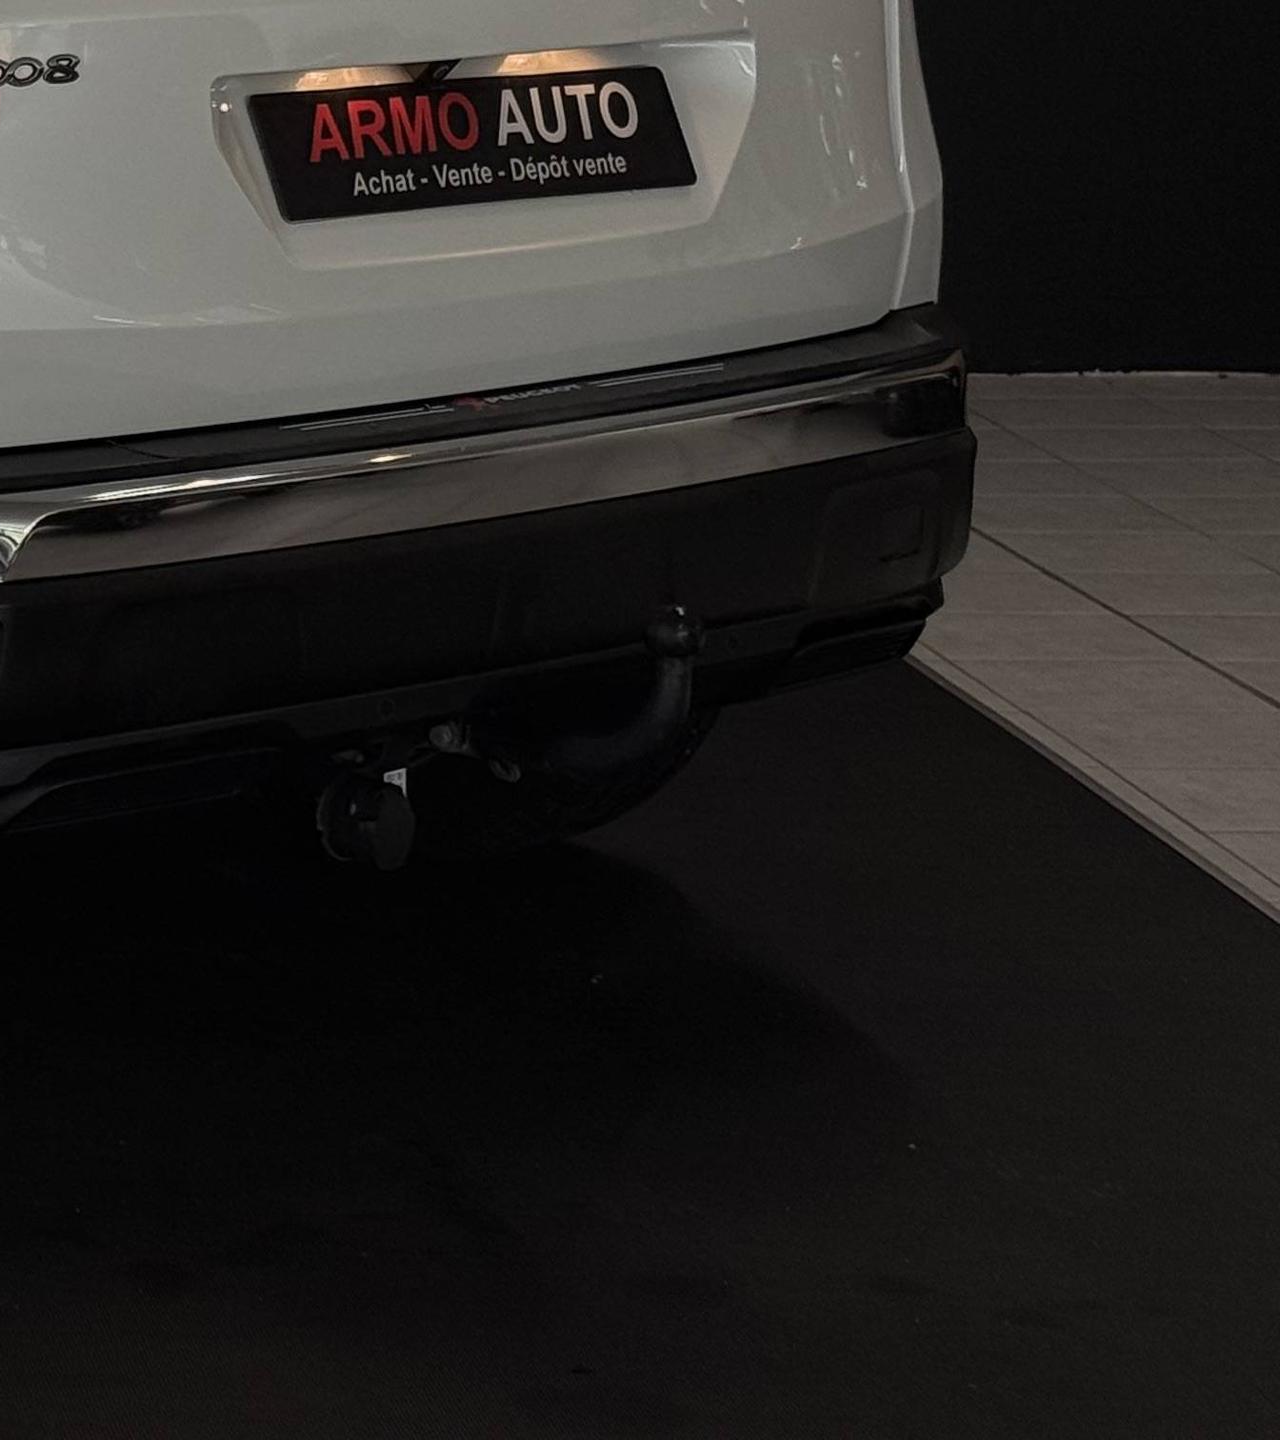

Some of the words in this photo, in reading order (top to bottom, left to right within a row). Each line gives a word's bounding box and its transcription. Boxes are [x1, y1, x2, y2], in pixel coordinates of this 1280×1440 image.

[308, 92, 479, 163] ARMO
[497, 81, 639, 147] AUTO
[352, 169, 417, 197] Achat
[432, 162, 494, 189] Vente
[510, 154, 571, 185] Dépôt
[575, 153, 628, 178] vente
